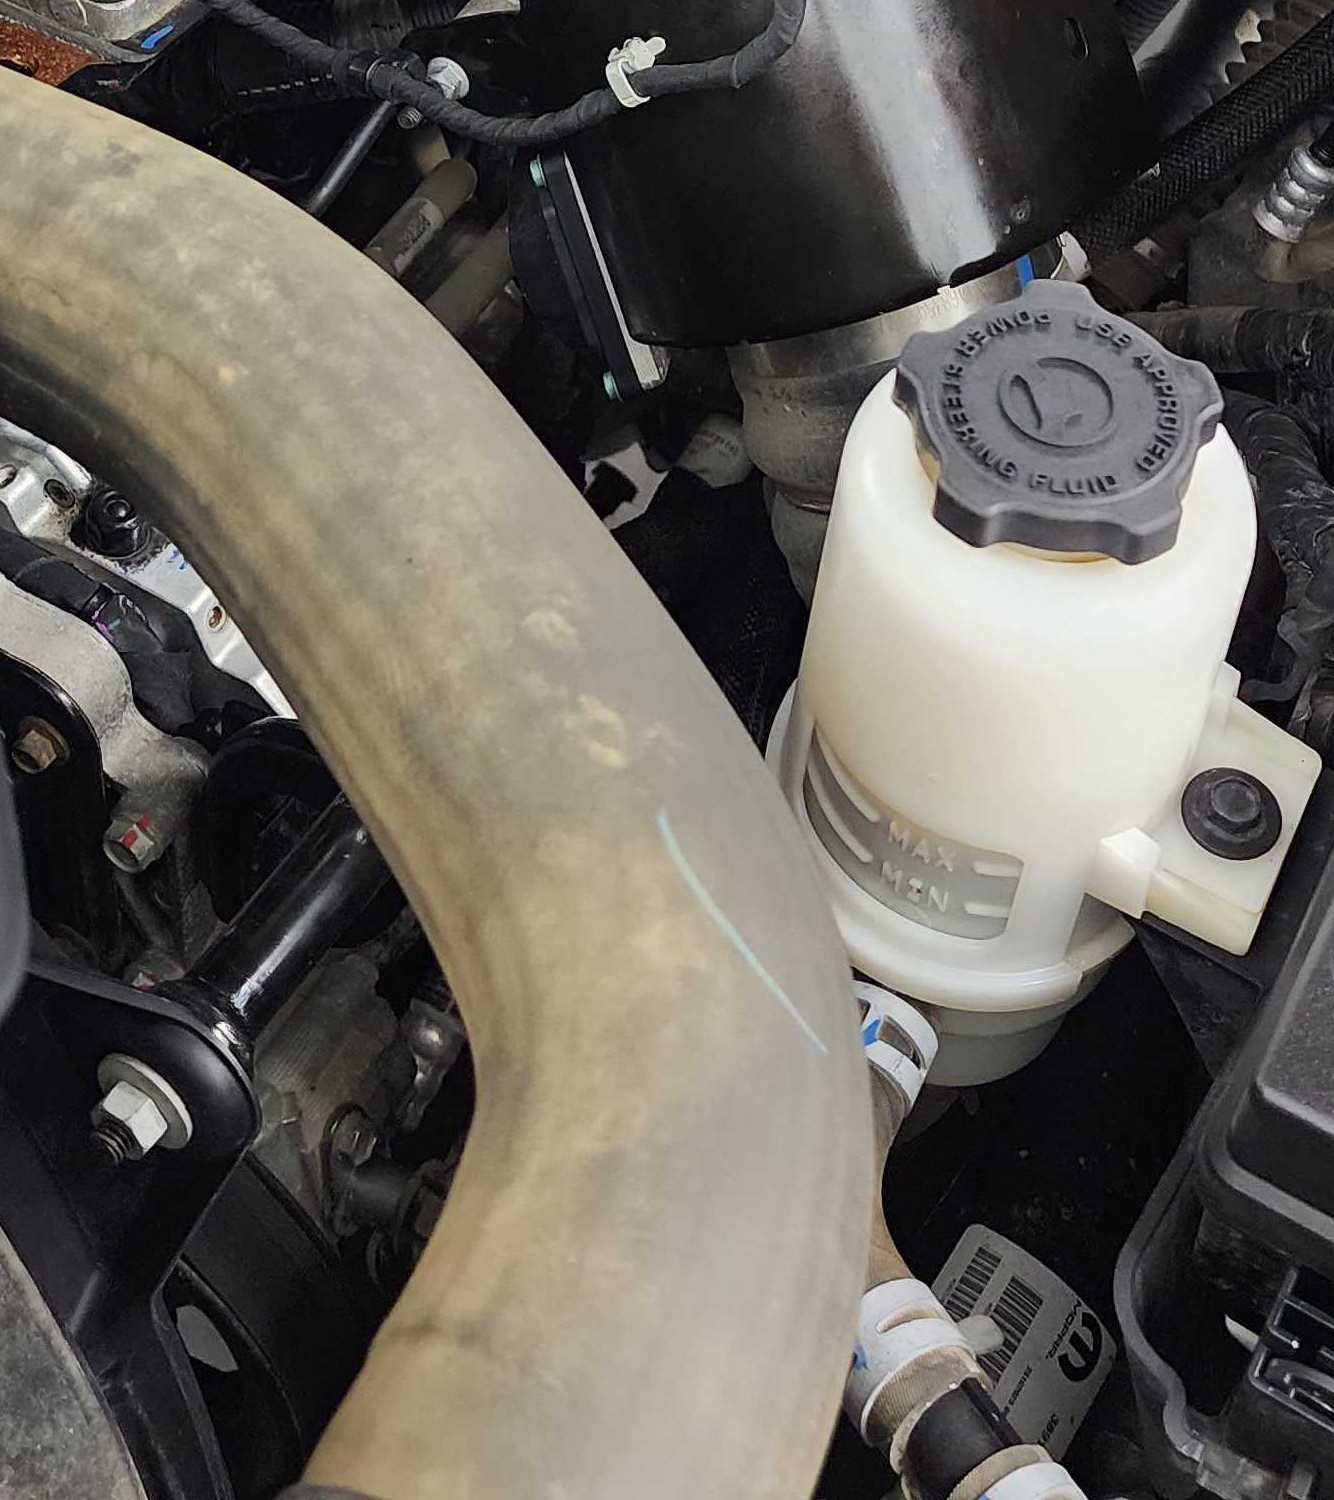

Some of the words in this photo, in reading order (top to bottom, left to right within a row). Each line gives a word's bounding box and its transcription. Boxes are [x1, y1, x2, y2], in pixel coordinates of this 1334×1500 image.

[954, 309, 1052, 359] POWER
[1075, 314, 1133, 350] USE
[1131, 352, 1179, 474] APPROVED
[942, 362, 1018, 480] STEERING
[1030, 473, 1119, 496] FLUID
[887, 820, 957, 873] MAX
[879, 860, 950, 913] MIN
